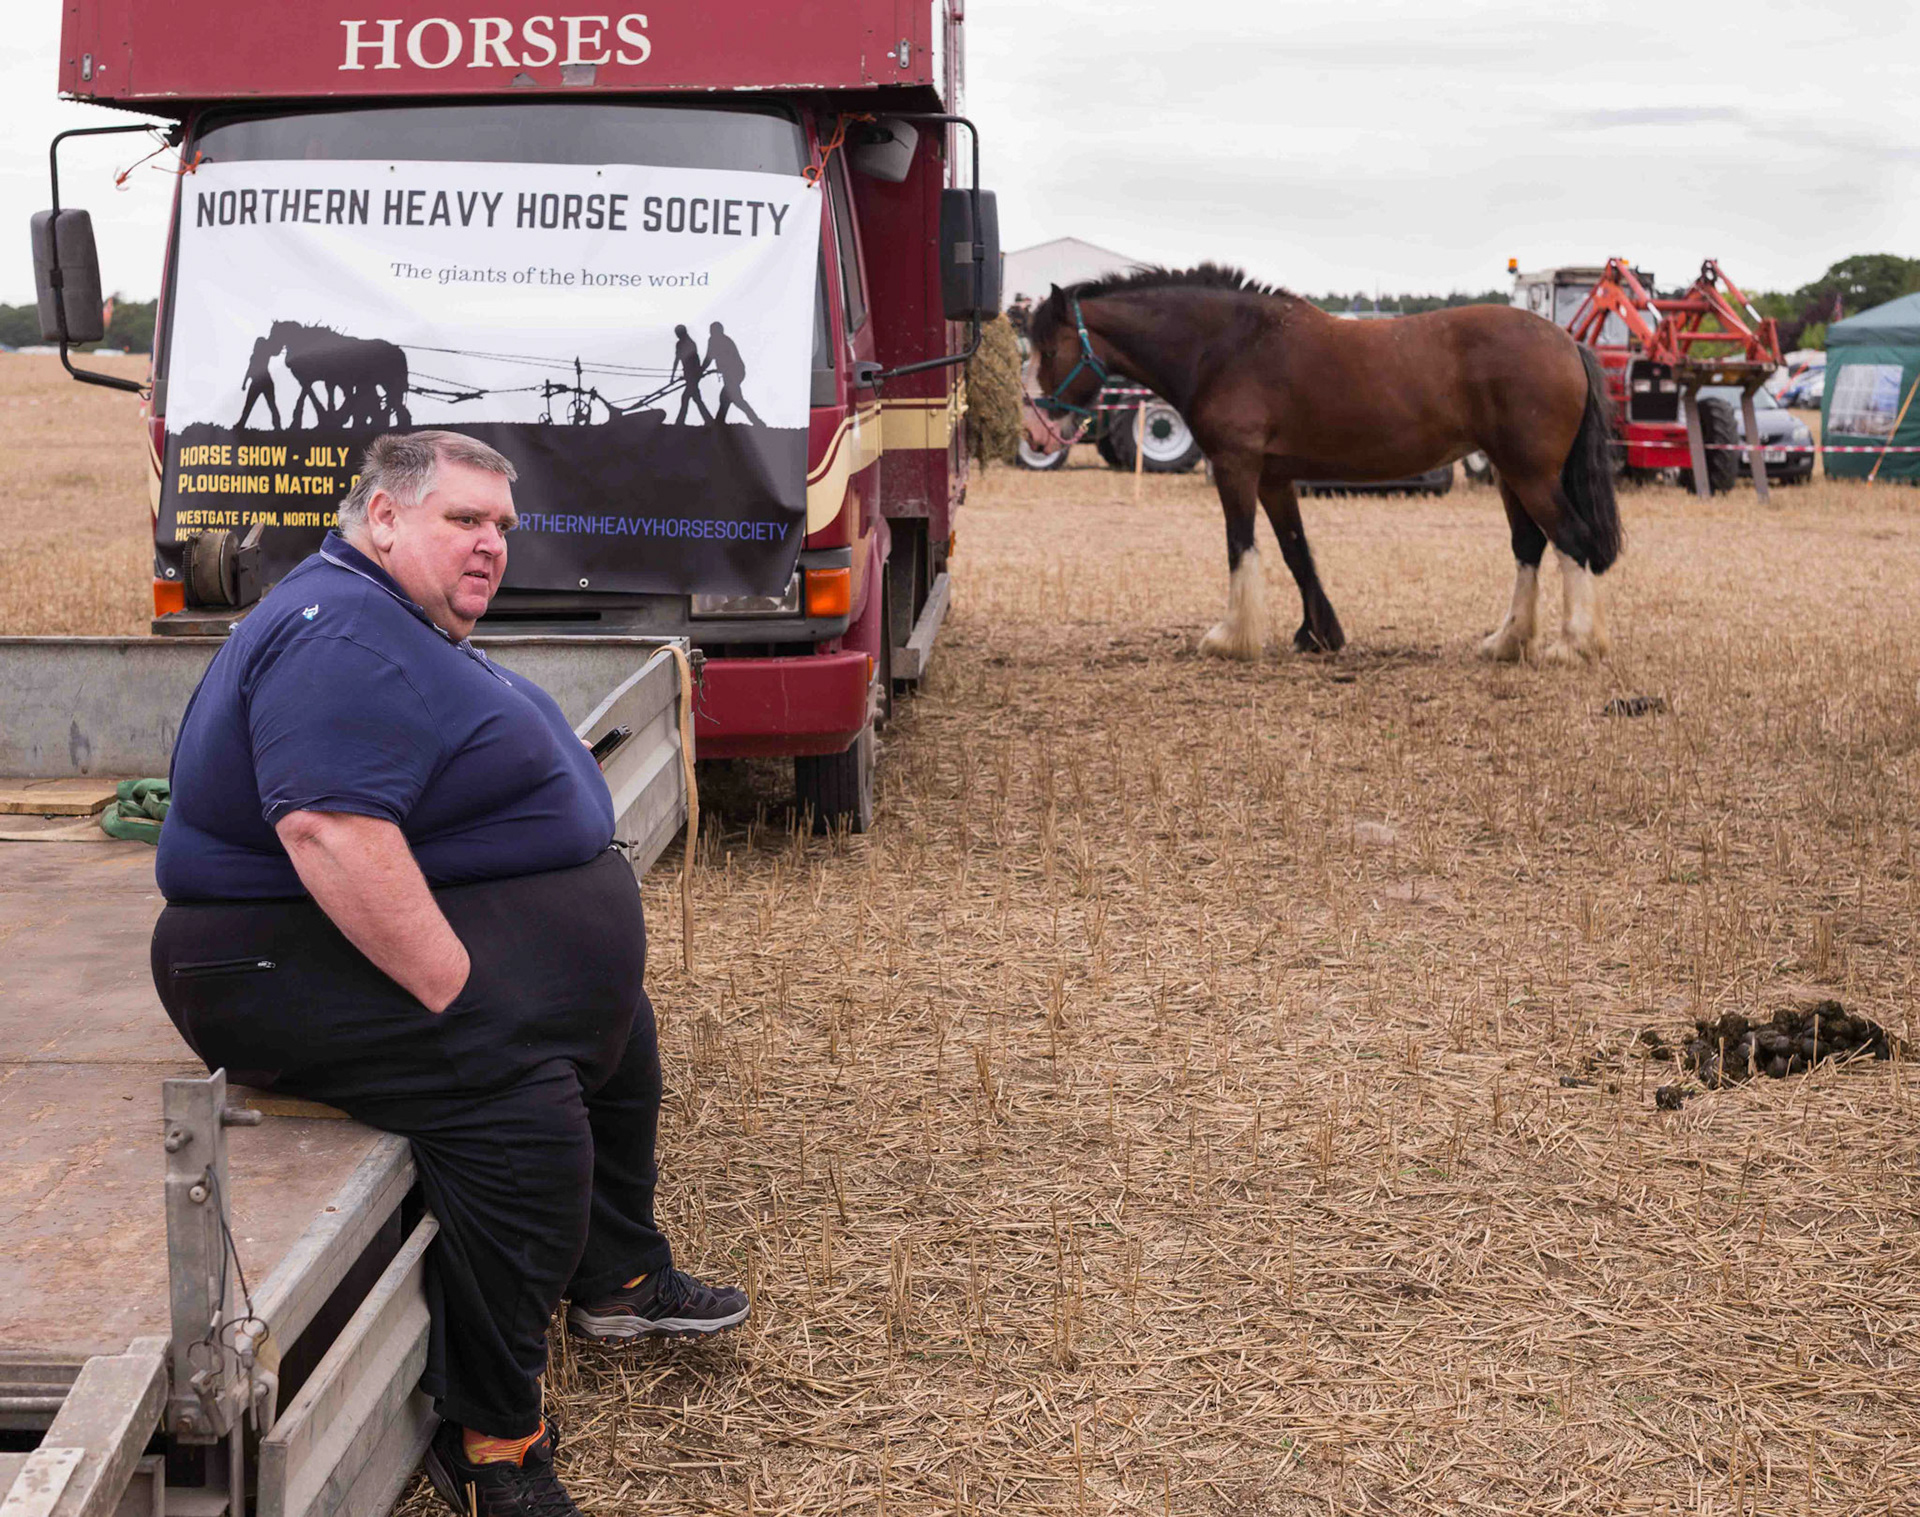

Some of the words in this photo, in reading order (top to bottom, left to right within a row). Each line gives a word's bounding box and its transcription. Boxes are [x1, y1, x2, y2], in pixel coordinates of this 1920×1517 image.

[338, 13, 652, 70] HORSES
[196, 189, 369, 228] NORTHERN
[383, 190, 504, 228] HEAVY
[516, 193, 629, 231] HORSE
[643, 196, 790, 237] SOCIETY
[390, 262, 433, 280] The
[438, 264, 507, 285] giants
[512, 266, 537, 285] of
[539, 267, 576, 286] the
[581, 268, 642, 287] horse
[647, 271, 709, 287] world
[179, 445, 232, 467] HORSE
[238, 446, 287, 467] SHOW
[304, 446, 350, 467] JULY
[178, 473, 270, 495] PLOUGHING
[274, 473, 334, 495] MATCH
[176, 510, 239, 525] WESTGATE
[242, 511, 280, 527] FARM,
[283, 511, 320, 527] NORTH
